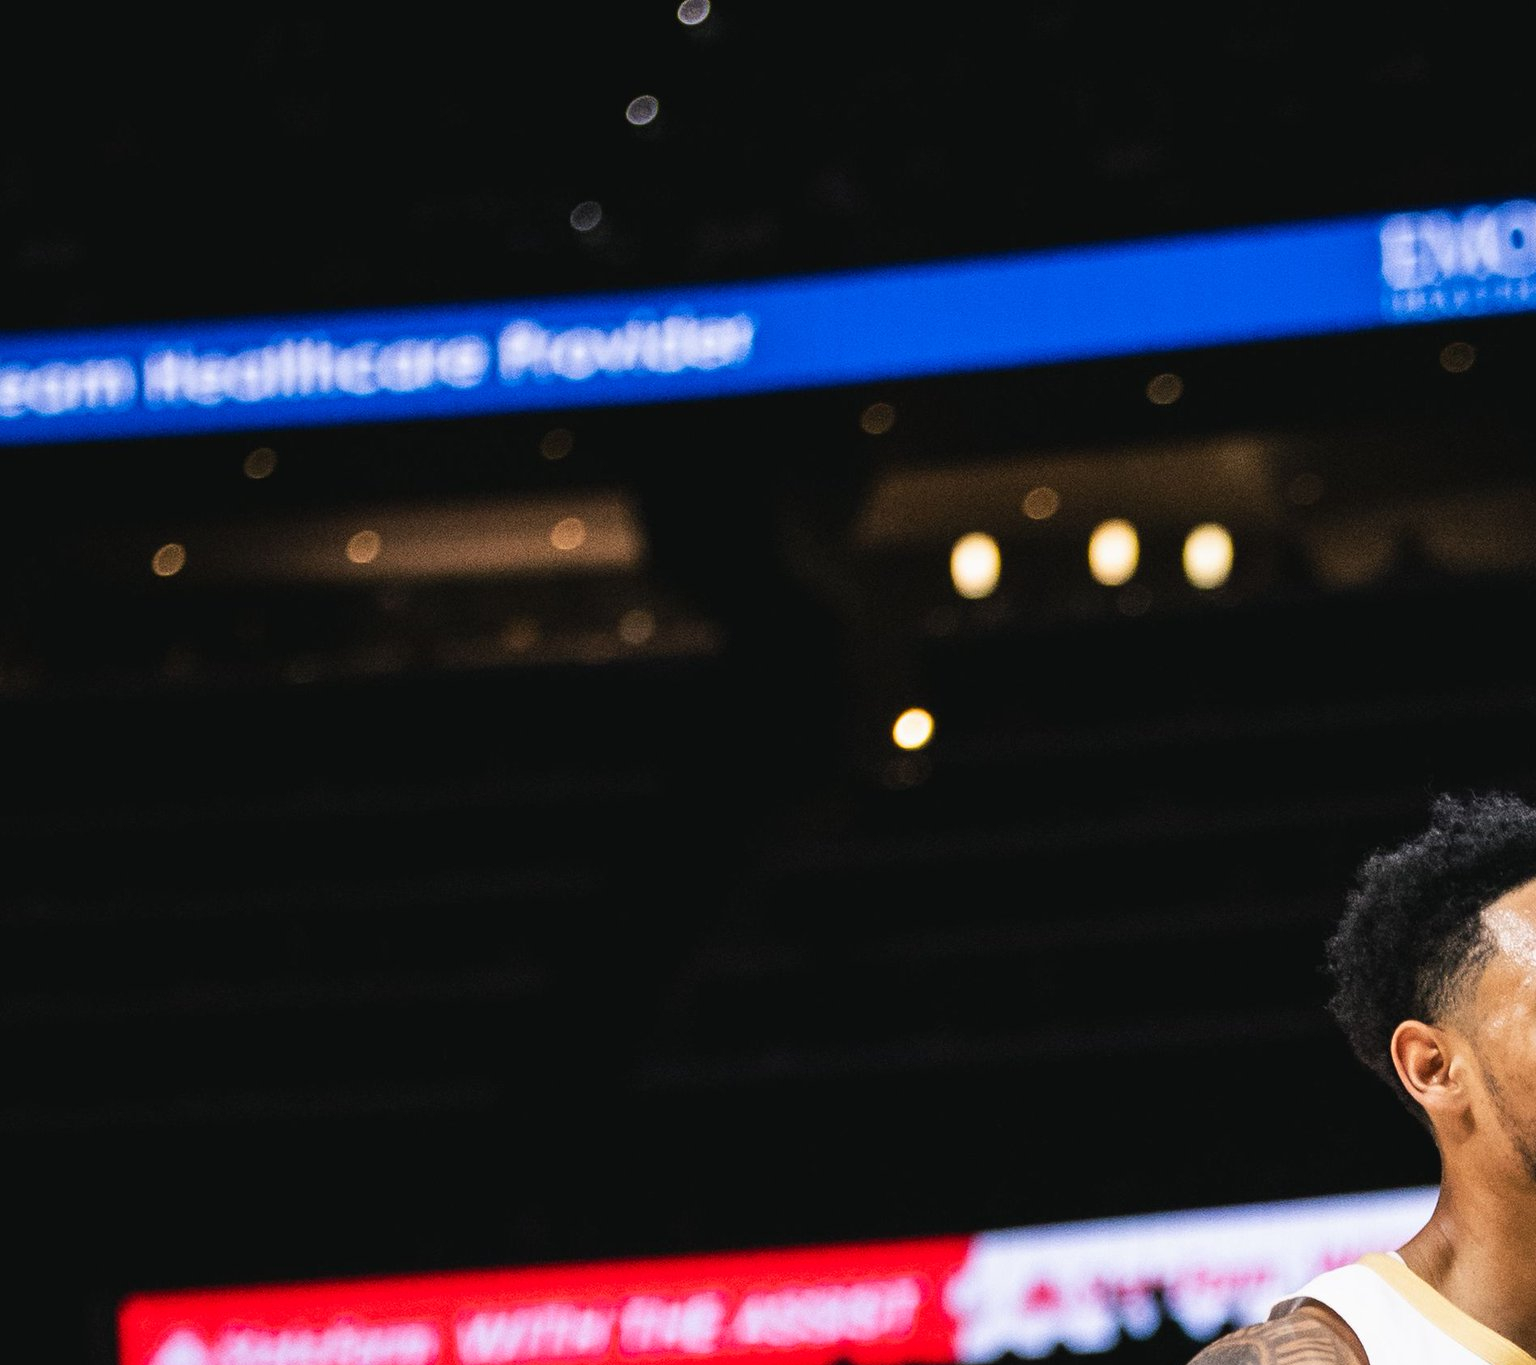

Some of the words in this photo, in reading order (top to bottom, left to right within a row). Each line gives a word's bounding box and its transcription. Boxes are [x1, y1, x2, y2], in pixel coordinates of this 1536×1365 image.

[143, 332, 490, 404] Healthcare
[499, 308, 755, 382] Provider
[455, 1303, 615, 1365] WITH
[620, 1291, 727, 1353] THE
